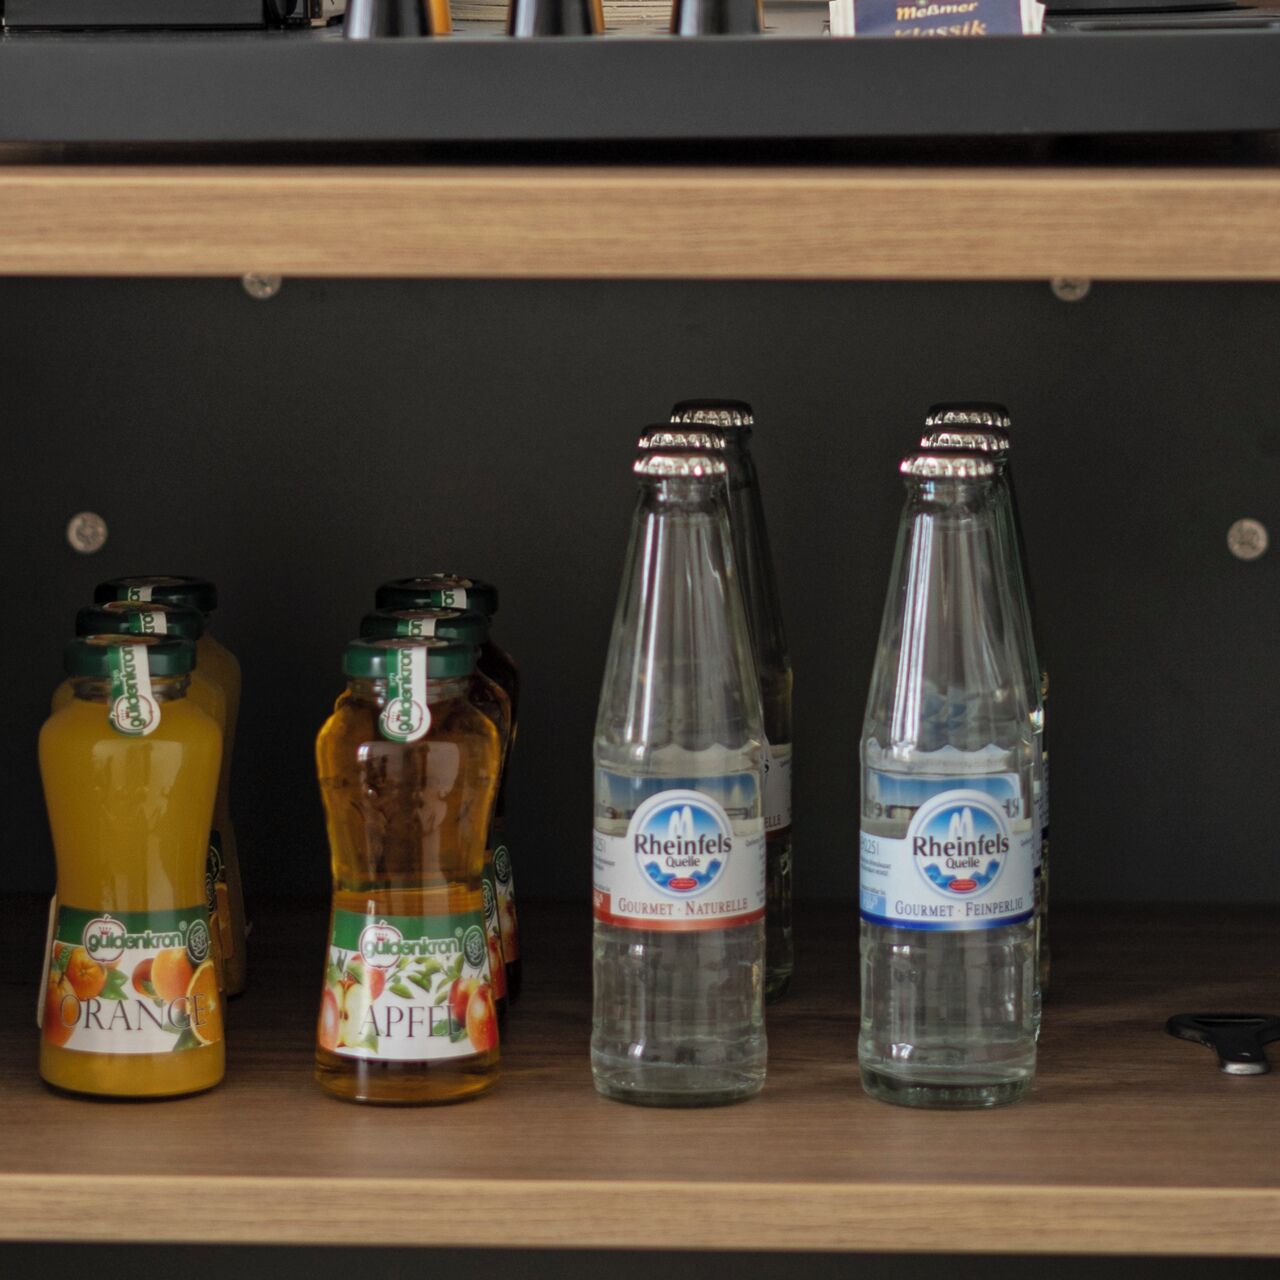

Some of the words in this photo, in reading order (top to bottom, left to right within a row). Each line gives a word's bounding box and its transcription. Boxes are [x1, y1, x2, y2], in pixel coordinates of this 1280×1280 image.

[896, 1, 979, 21] Meßmer
[634, 833, 732, 856] Rheinfels
[912, 833, 1010, 857] Rheinfels
[665, 856, 700, 868] Quelle
[945, 856, 980, 869] Quelle
[619, 897, 674, 916] GOURMET
[685, 897, 748, 916] NATURELLE
[895, 899, 954, 917] GOURMET
[965, 897, 1023, 917] FEINPERLIG
[60, 993, 207, 1031] ORANGE
[358, 1004, 460, 1038] APFEL
